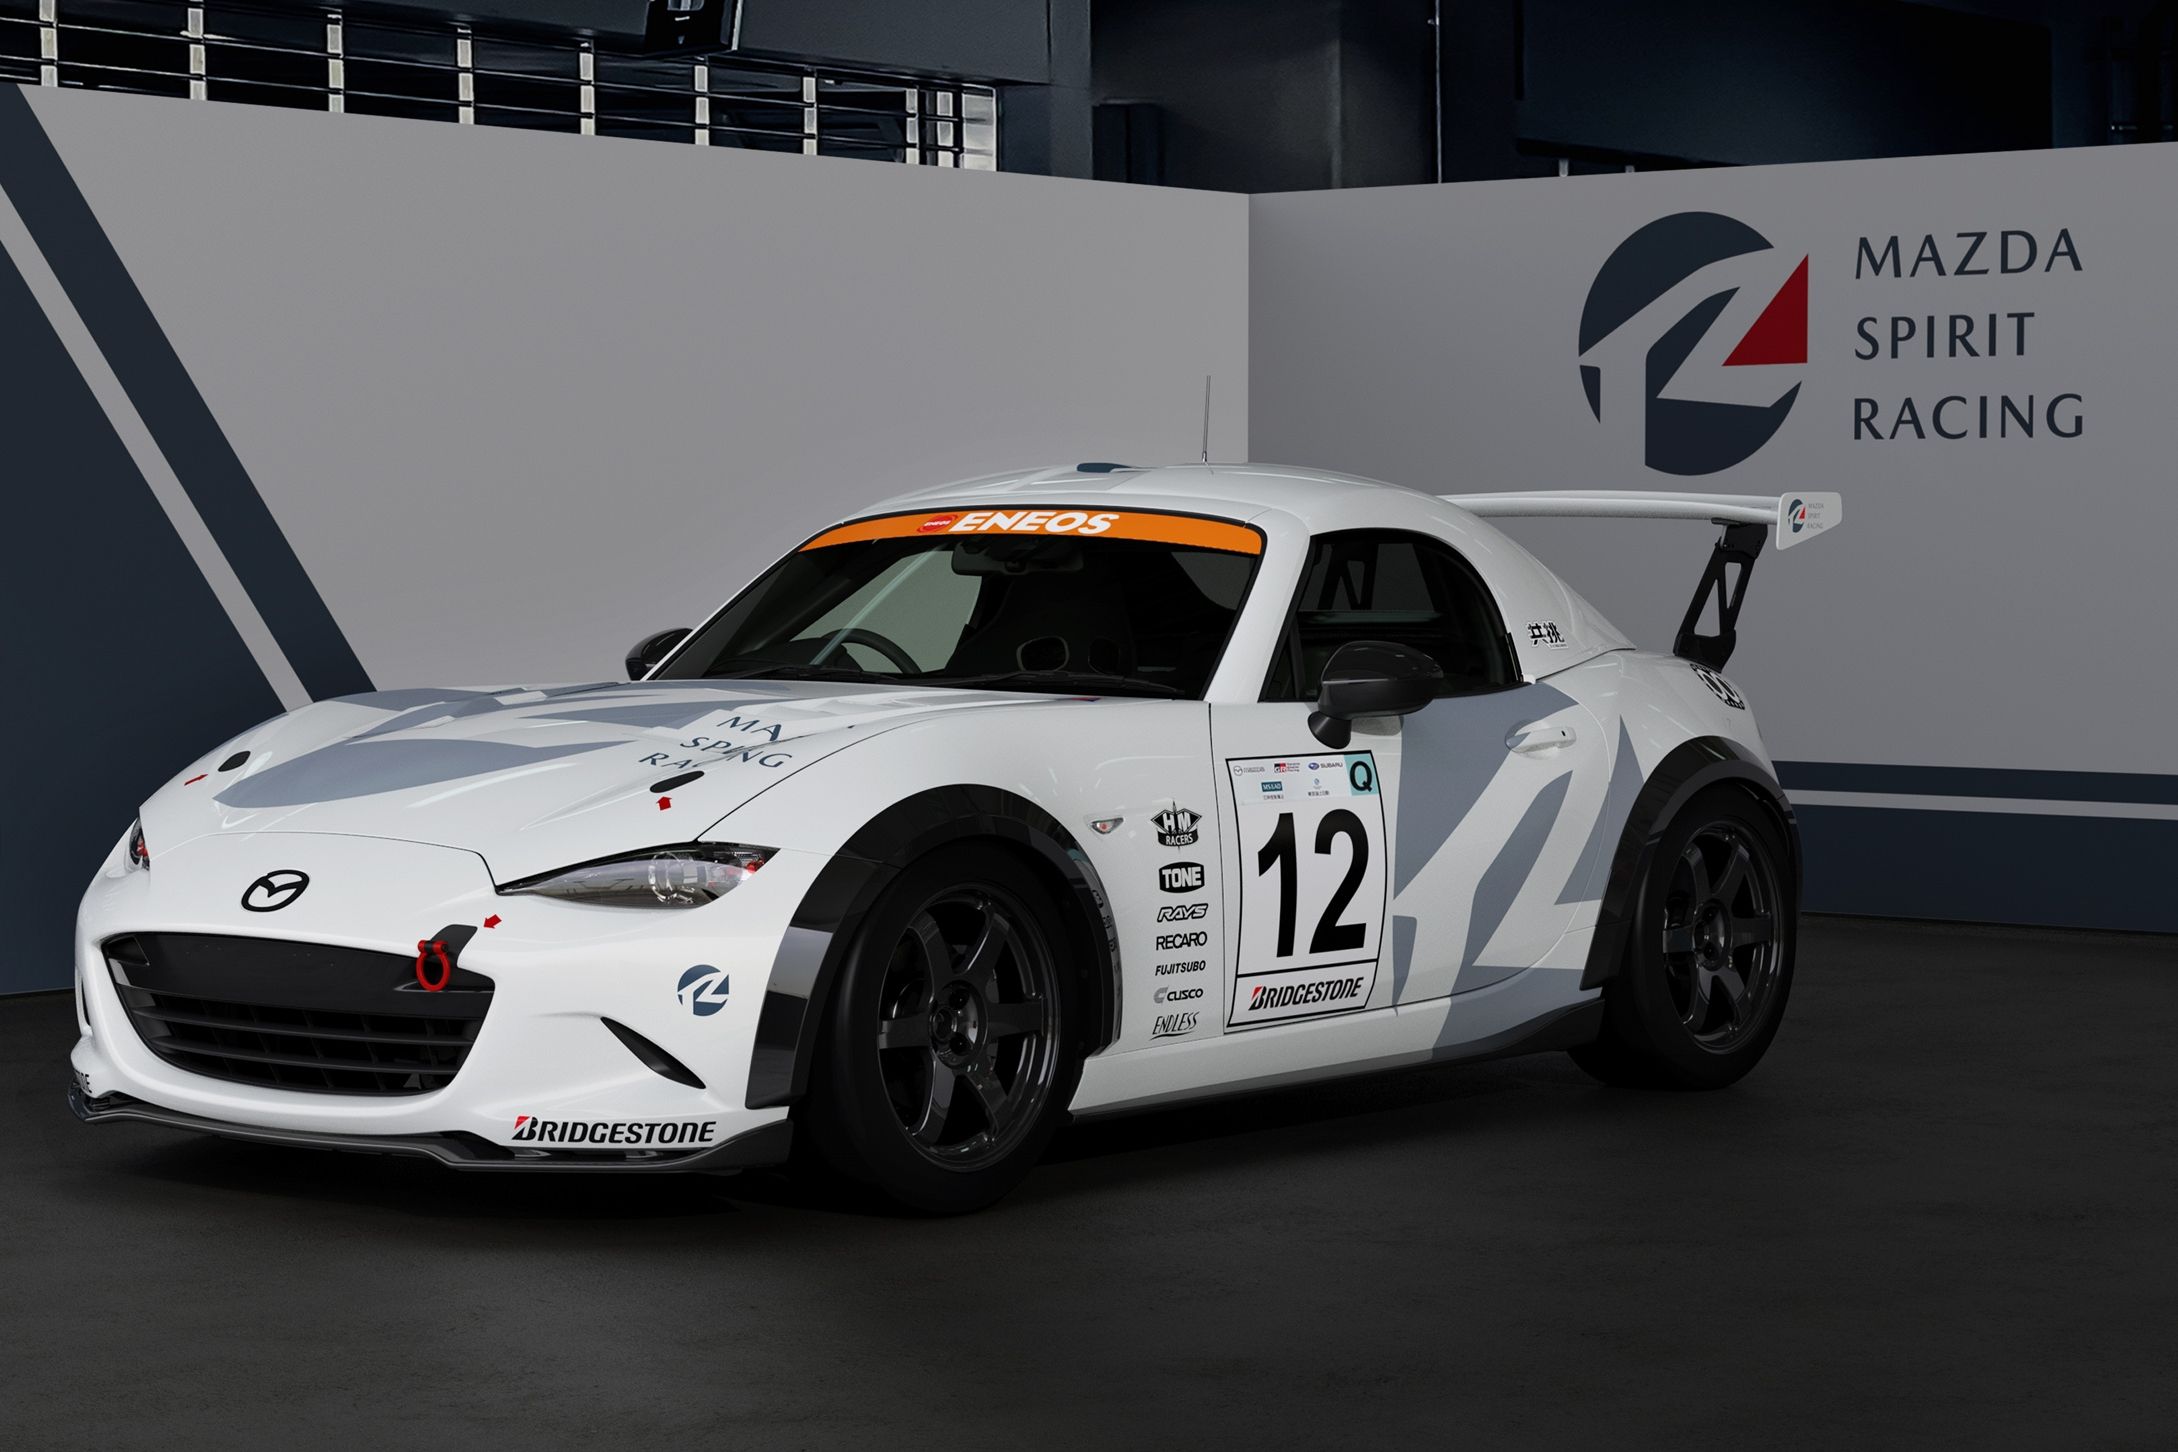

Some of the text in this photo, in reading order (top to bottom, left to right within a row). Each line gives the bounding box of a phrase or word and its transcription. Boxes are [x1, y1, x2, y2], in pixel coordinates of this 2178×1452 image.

[1854, 227, 2085, 281] MAZDA
[1854, 311, 2036, 361] SPIRIT
[1853, 393, 2085, 441] RACING
[948, 511, 1120, 535] ENEOS
[1349, 760, 1373, 792] Q
[1165, 833, 1194, 846] RACERS
[1161, 866, 1202, 889] TONE
[1257, 808, 1370, 958] 12
[1157, 903, 1208, 923] RAYS
[1156, 931, 1208, 950] RECARO
[1155, 960, 1206, 976] FUJITSUBO
[1248, 977, 1364, 1011] BRIDGESTONE
[1151, 1011, 1200, 1035] ENDLESS
[511, 1115, 717, 1144] BRIDGESTONE
